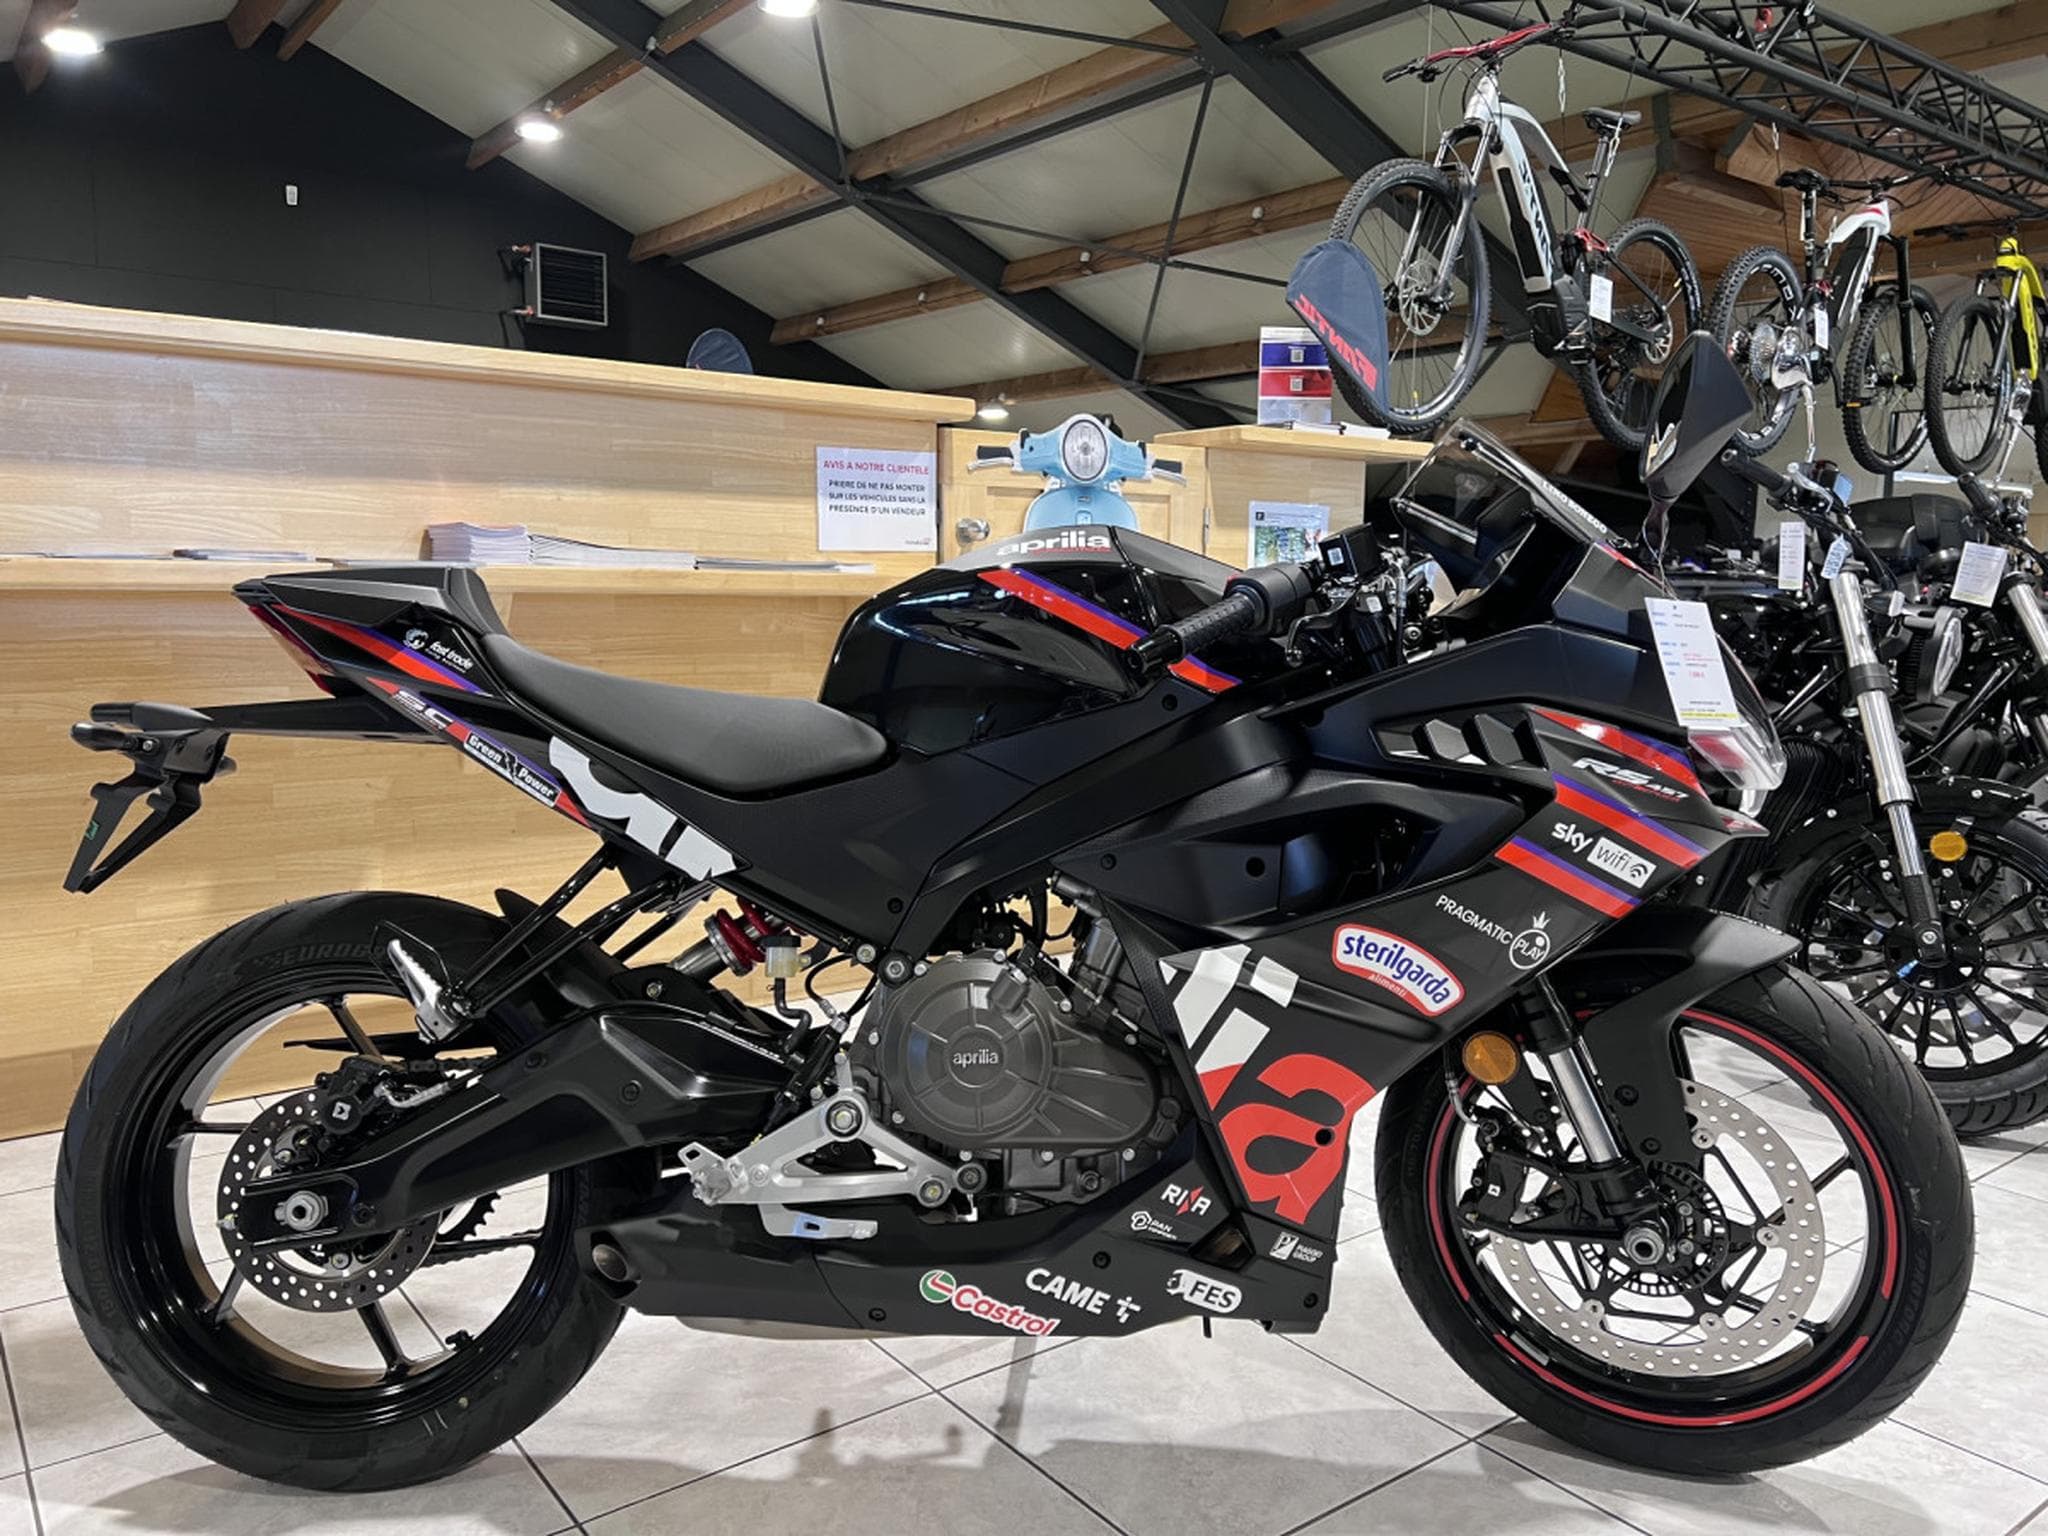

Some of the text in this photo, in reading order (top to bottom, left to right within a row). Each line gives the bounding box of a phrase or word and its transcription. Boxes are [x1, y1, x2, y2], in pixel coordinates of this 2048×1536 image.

[823, 460, 929, 475] AVIS A NOTRE CLIENTELE
[828, 480, 925, 492] PRIERE DE NE PAS MONTER
[829, 492, 843, 500] SUR
[845, 492, 857, 501] LES
[859, 494, 897, 502] VEHICULES
[829, 504, 926, 515] PRESENCE D'UN VENDEUR
[996, 530, 1111, 556] aprilia
[468, 734, 503, 764] Green
[518, 766, 555, 798] Power
[1571, 757, 1654, 785] RS
[1551, 822, 1633, 872] sky wifi
[1435, 895, 1513, 945] PRAGMATIC
[1514, 938, 1545, 961] PLAY
[1343, 934, 1451, 1004] sterilgarda
[1367, 973, 1409, 998] alimenti
[953, 1048, 999, 1068] aprilia
[1024, 1267, 1111, 1315] CAME
[1189, 1280, 1237, 1309] FES
[951, 1284, 1061, 1336] Castrol
